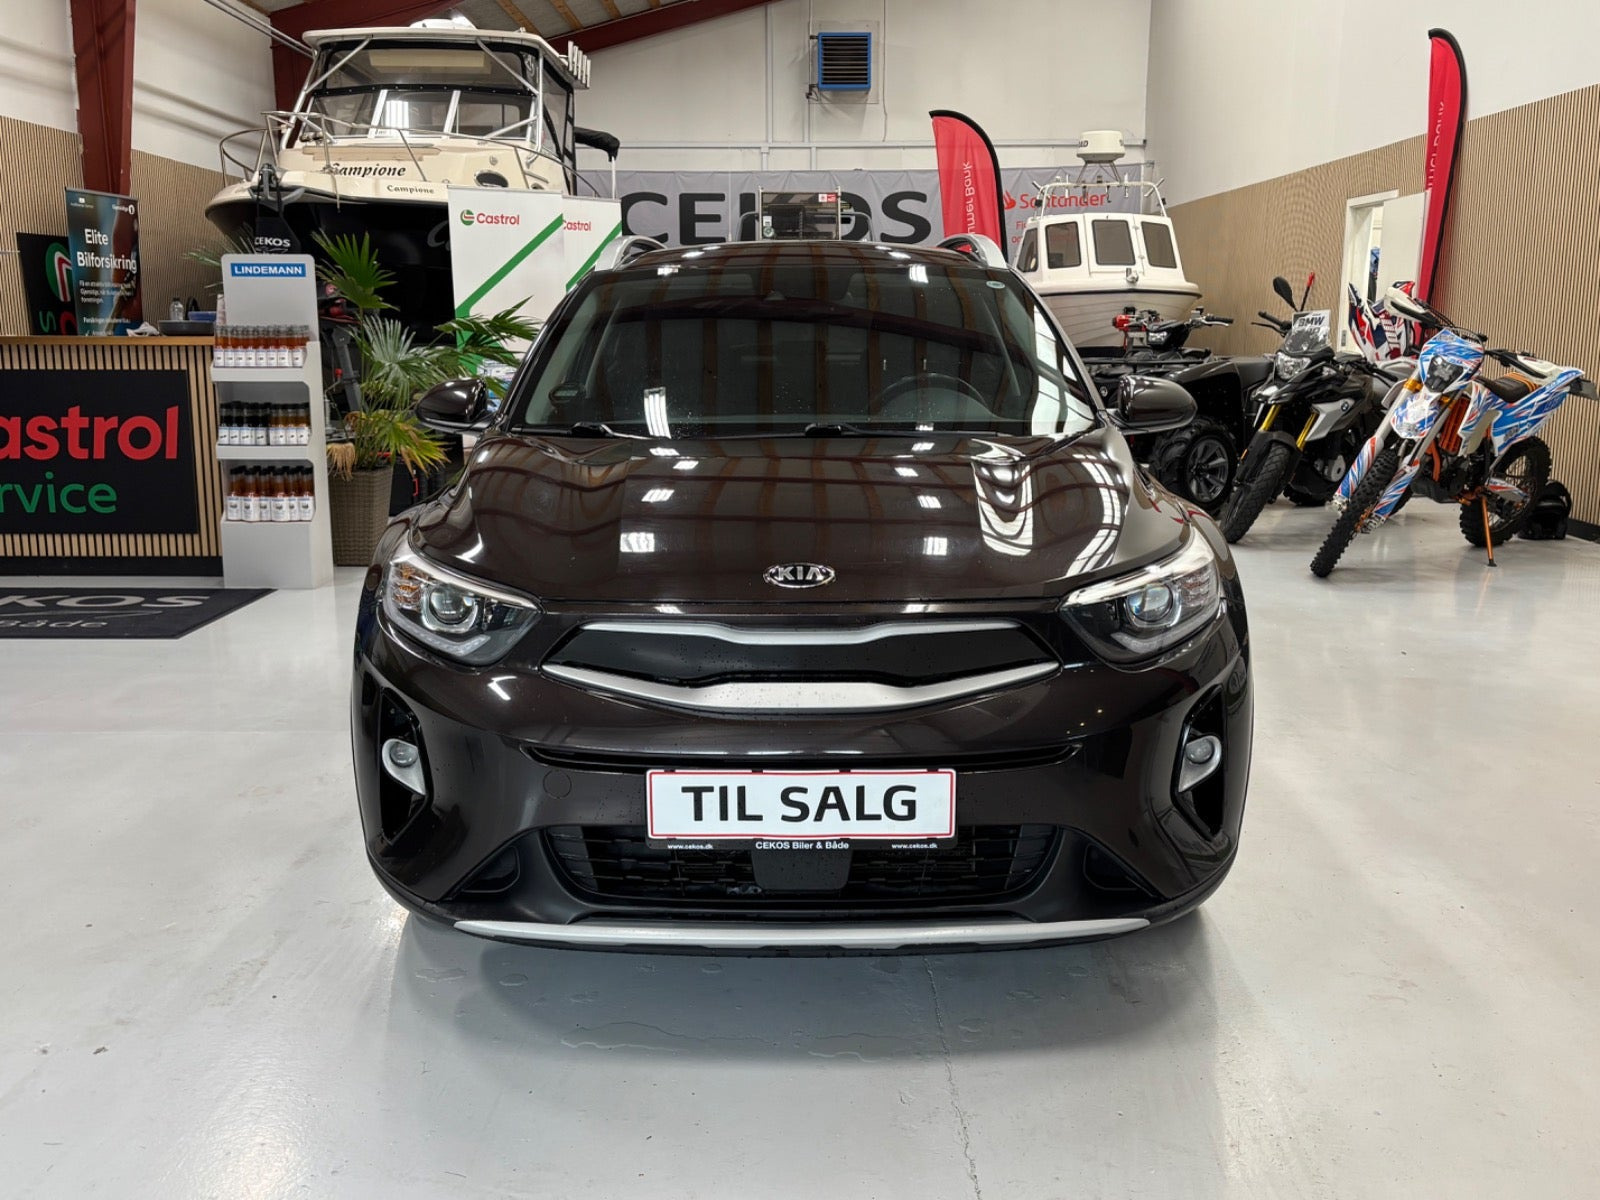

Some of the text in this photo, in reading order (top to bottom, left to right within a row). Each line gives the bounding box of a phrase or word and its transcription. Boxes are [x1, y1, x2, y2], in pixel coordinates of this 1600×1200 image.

[386, 184, 435, 195] Campione
[476, 207, 520, 225] Castrol
[84, 228, 109, 245] Elite
[254, 236, 291, 248] CEKOS
[76, 251, 138, 274] Bilforsikring
[233, 265, 302, 275] LINDEMANN
[773, 565, 825, 581] KIA
[681, 784, 917, 823] TIL SALG
[755, 840, 850, 850] CEKOS Biler & Både
